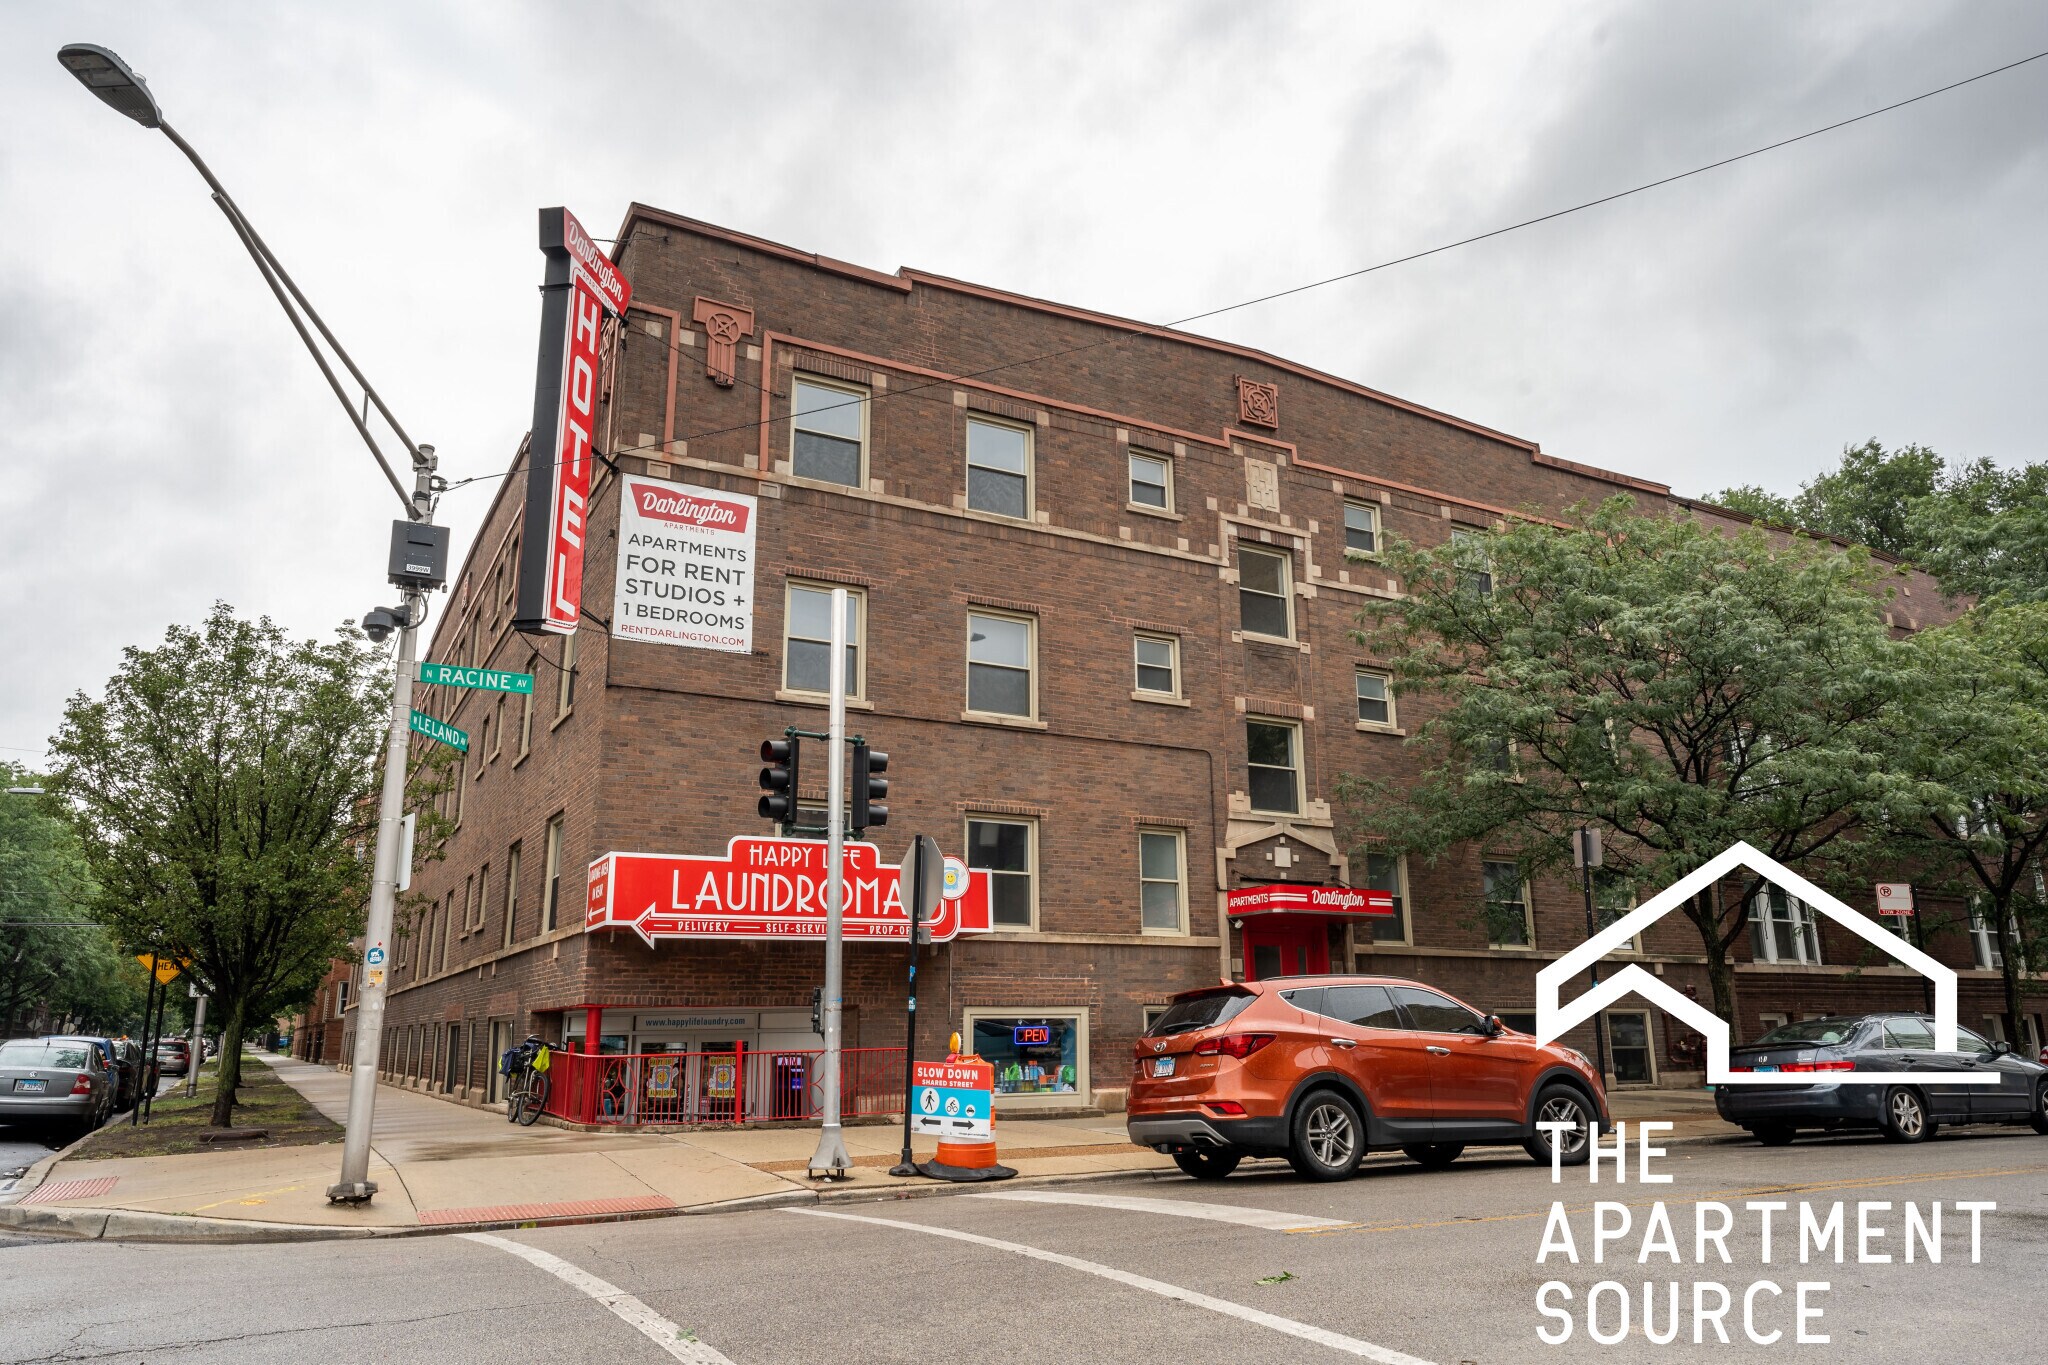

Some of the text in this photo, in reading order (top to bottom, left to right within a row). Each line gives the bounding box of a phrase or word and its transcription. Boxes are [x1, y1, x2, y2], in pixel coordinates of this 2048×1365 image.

[569, 221, 623, 302] Darlington
[556, 291, 598, 617] HOTEL
[643, 492, 736, 524] Darlington
[663, 522, 715, 536] APARTMENTS
[628, 533, 747, 562] APARTMENTS
[626, 554, 746, 586] FOR RENT
[625, 578, 726, 606] STUDIOS
[623, 602, 745, 630] 1 BEDROOMS
[621, 624, 745, 646] RENTDARLINGTON.COM
[426, 667, 527, 689] N RACINE AV
[418, 719, 459, 745] LELAND
[749, 844, 861, 870] HAPPY LFE
[671, 869, 908, 914] LAUNDROMA
[1229, 889, 1365, 910] APARTMENTS Darlington
[677, 920, 910, 935] DELIVERY SELF-SERVI DROP-OF
[645, 1017, 746, 1028] www.happylifelaundry.com
[1017, 1028, 1048, 1042] OPEN
[917, 1066, 979, 1080] SLOW DOWN
[921, 1078, 974, 1088] SHARED STREET
